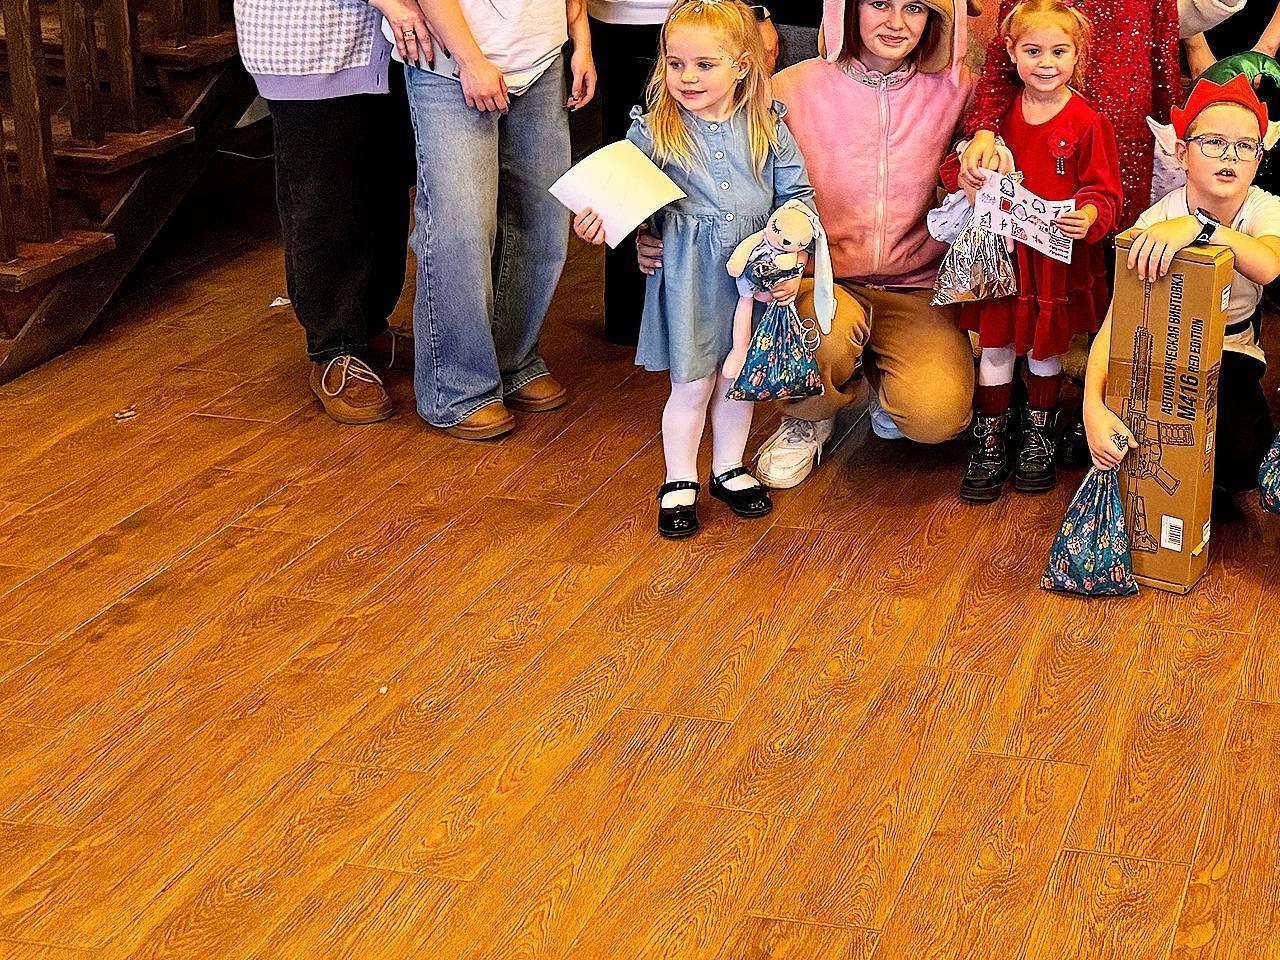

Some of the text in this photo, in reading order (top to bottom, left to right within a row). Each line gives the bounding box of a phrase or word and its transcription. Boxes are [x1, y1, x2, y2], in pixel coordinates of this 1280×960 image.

[1160, 273, 1185, 416] АВТОМАТИЧЕСКАЯ ВИНТОВКА
[1176, 318, 1205, 422] M416 RED EDITION
